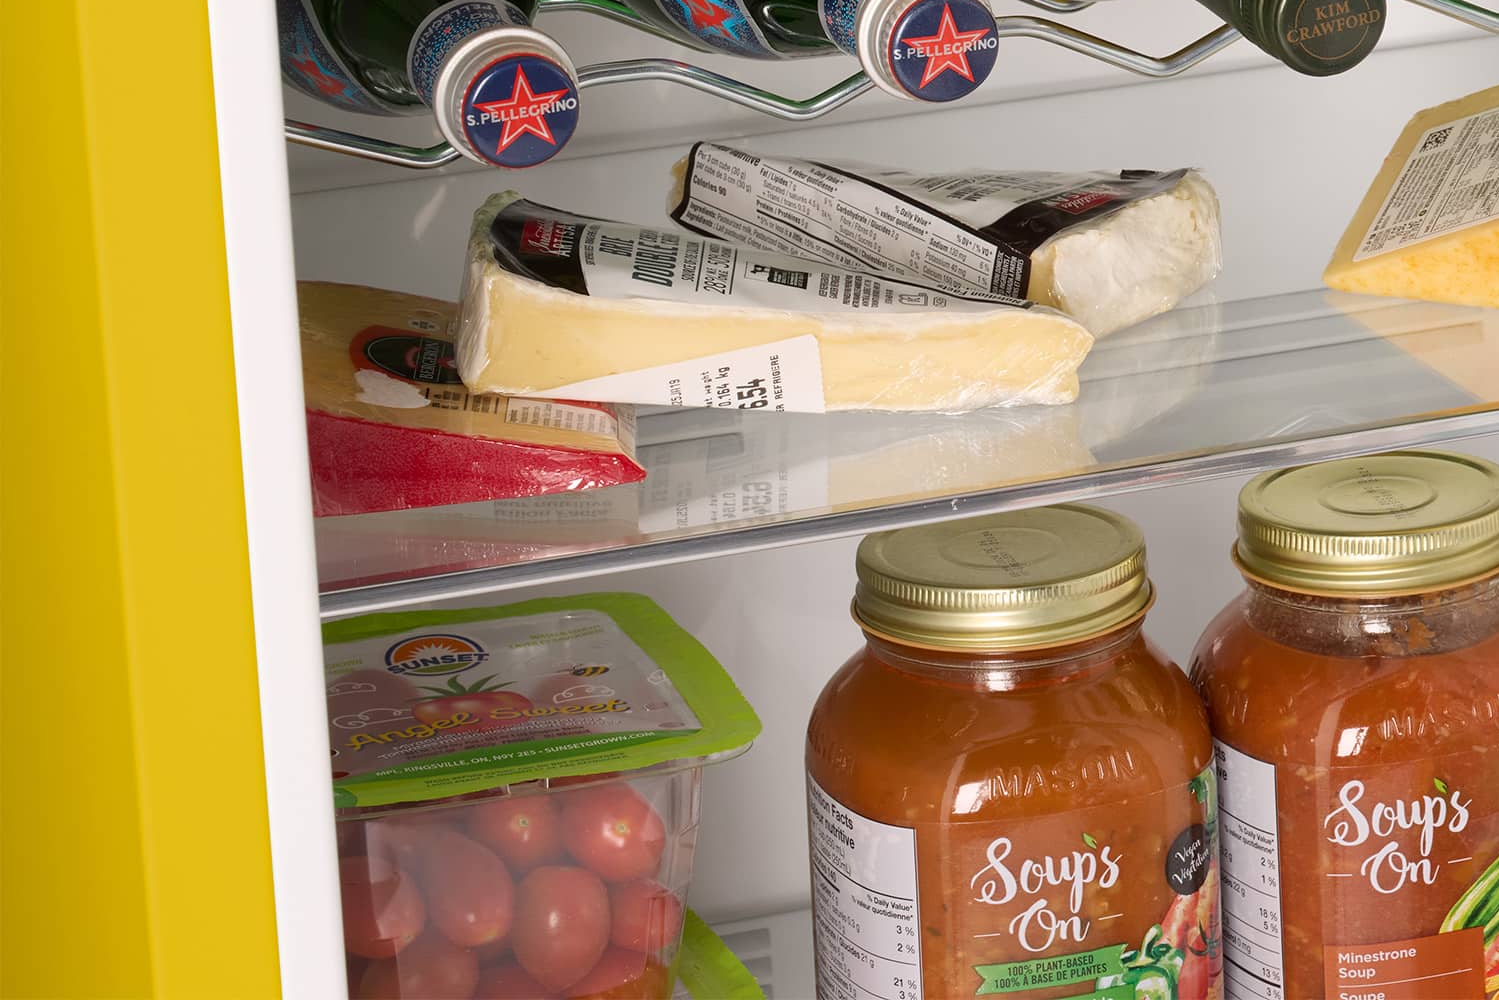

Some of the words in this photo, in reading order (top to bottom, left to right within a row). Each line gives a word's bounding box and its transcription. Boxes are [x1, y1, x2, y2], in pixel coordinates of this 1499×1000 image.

[1315, 0, 1350, 20] KIM
[1286, 8, 1382, 45] CRAWFORD
[600, 235, 634, 257] BRIE
[715, 367, 731, 380] kg
[770, 354, 783, 400] REFRIGERE
[387, 652, 490, 675] SUNSET
[490, 698, 632, 721] Sweet
[345, 711, 479, 750] Angel
[832, 804, 854, 831] Facts
[1175, 839, 1201, 863] Vegan
[1360, 841, 1440, 894] On
[905, 927, 915, 937] %
[1009, 898, 1090, 952] On
[906, 944, 915, 954] %
[1338, 947, 1416, 964] Minestrone
[994, 975, 1021, 989] 100%
[1031, 971, 1054, 985] BASE
[1056, 969, 1067, 981] DE
[1070, 963, 1107, 980] PLANTES
[1007, 963, 1033, 977] 100%
[1036, 955, 1094, 974] PLANT-BASED
[1338, 966, 1376, 980] Soup
[894, 977, 903, 987] 21
[908, 979, 917, 989] %
